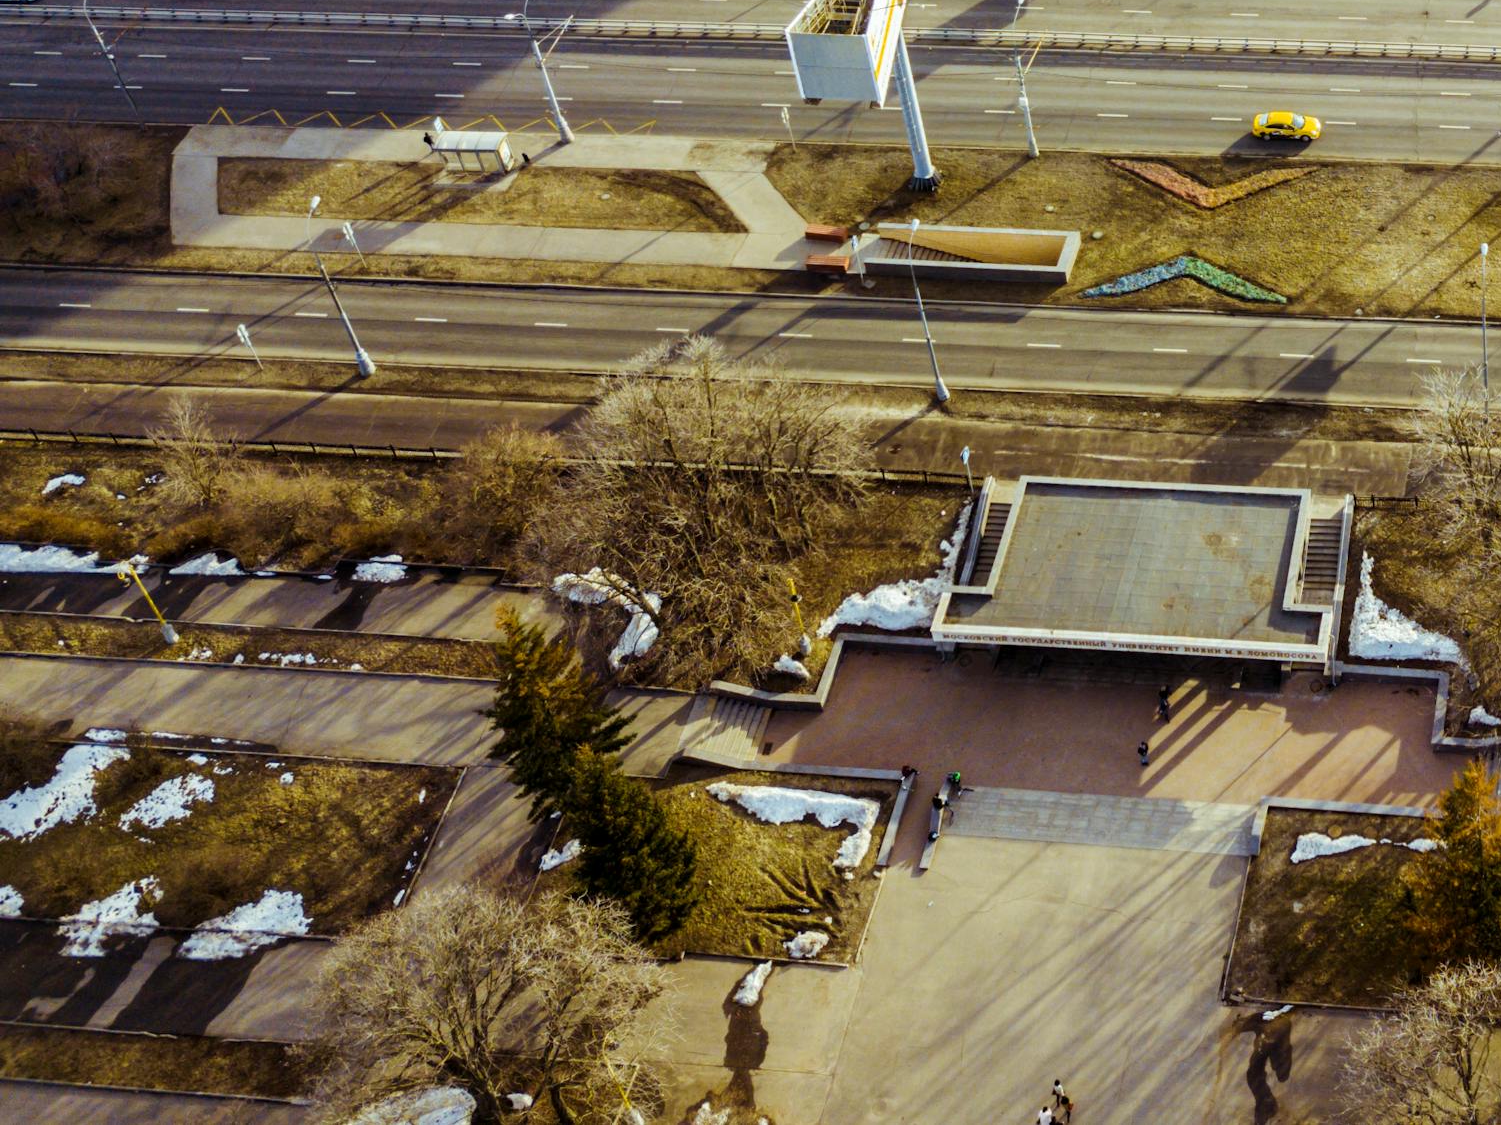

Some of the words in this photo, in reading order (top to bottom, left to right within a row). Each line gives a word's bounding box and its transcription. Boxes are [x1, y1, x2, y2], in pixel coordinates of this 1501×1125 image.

[943, 634, 1008, 642] МОСКОВСКИЙ
[1012, 636, 1107, 647] ГОСУДАРСТВЕННЫЙ
[1111, 641, 1180, 652] УНИВЕРСИТЕТ
[1184, 646, 1221, 655] ИМЕНИ
[1247, 649, 1318, 660] ЛОМОНОСОВА
